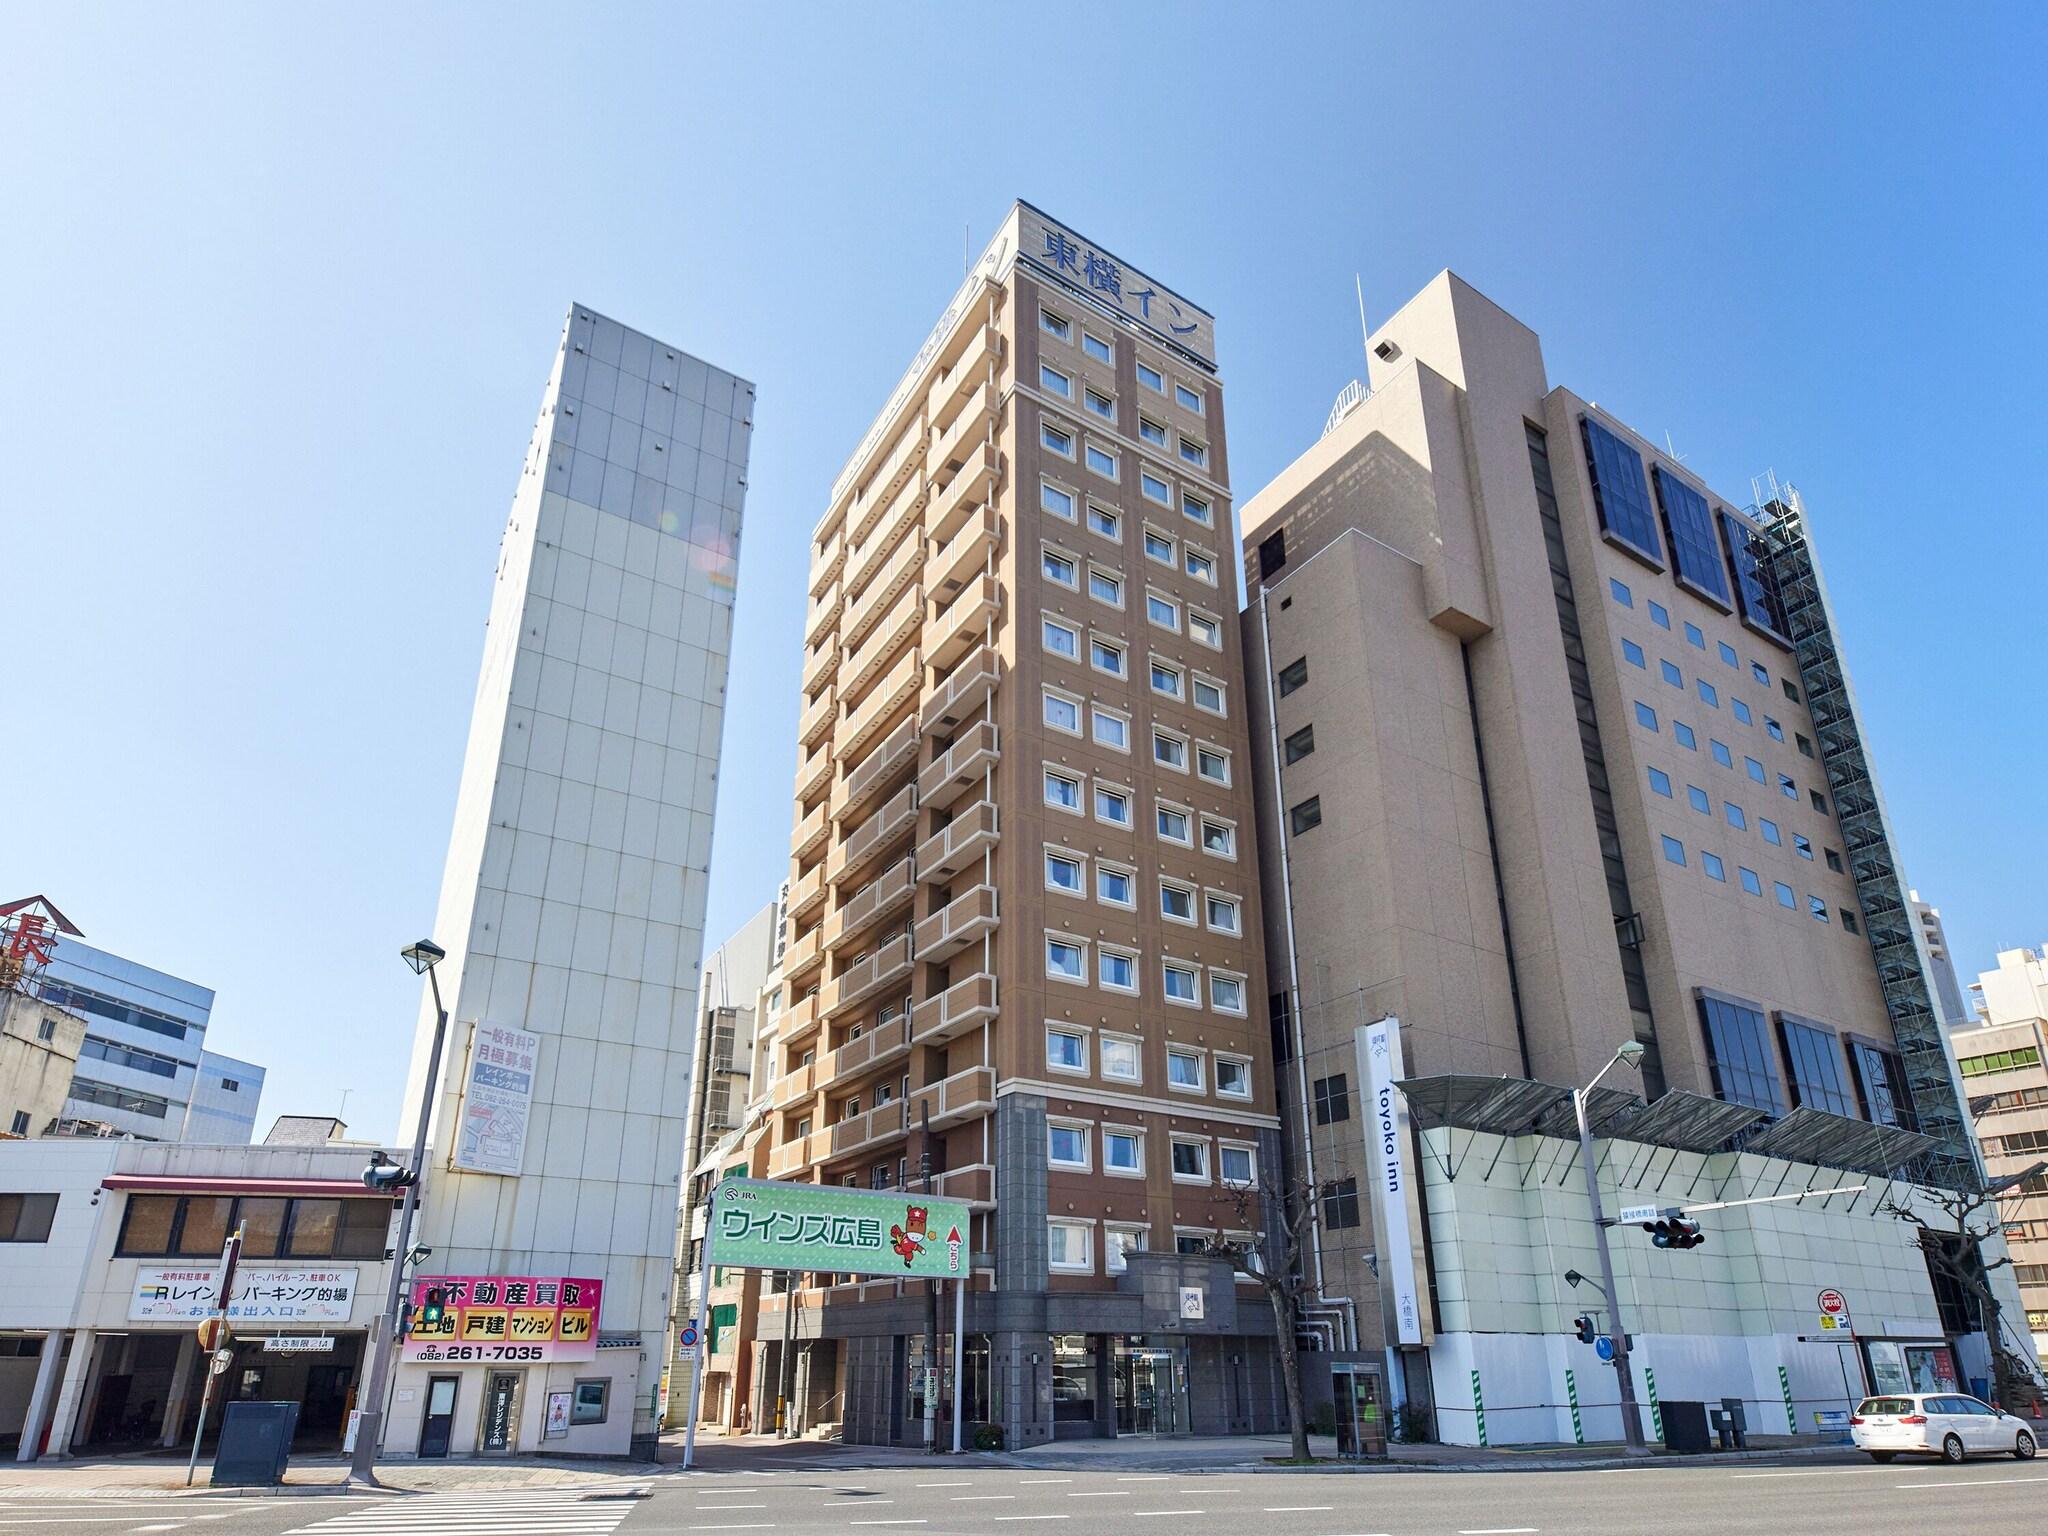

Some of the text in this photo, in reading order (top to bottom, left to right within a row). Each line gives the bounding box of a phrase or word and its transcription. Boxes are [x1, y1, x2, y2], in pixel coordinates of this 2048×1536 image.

[1041, 227, 1197, 334] 東横イン
[481, 1027, 535, 1052] 一般有料P
[1379, 1087, 1399, 1192] toyoko inn
[741, 1192, 757, 1201] JRA
[723, 1208, 882, 1248] ウインズ広島
[950, 1243, 958, 1270] こちら
[444, 1282, 580, 1304] 不動産買取
[466, 1315, 505, 1334] 戸建
[512, 1317, 553, 1333] マンション
[562, 1316, 588, 1334] ビル
[447, 1346, 542, 1360] 261-7035
